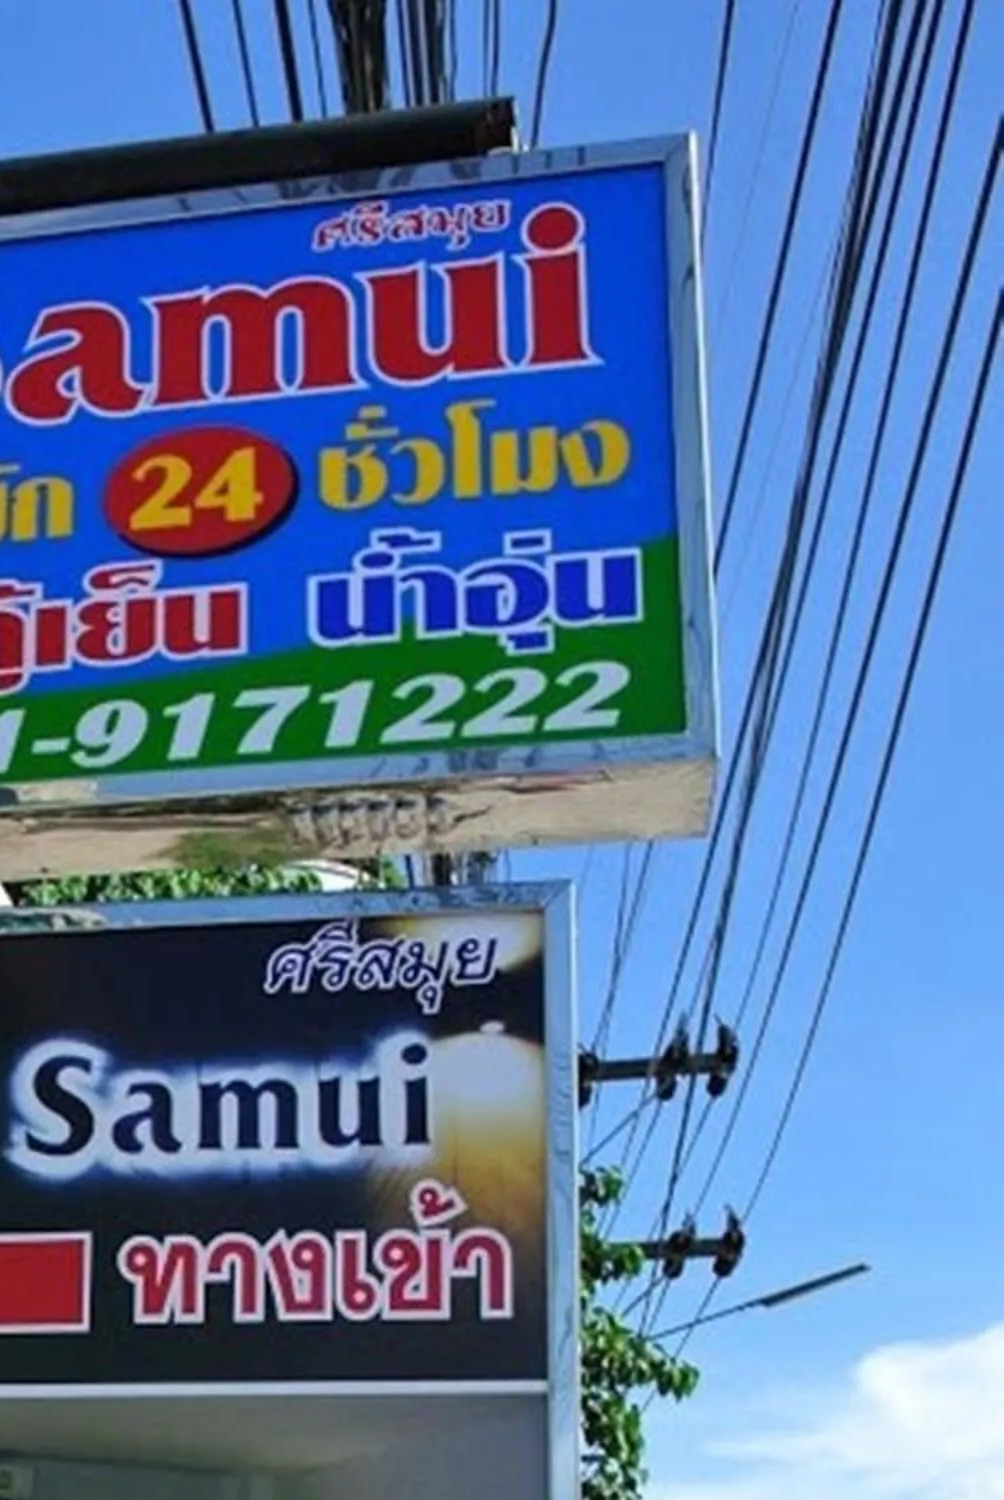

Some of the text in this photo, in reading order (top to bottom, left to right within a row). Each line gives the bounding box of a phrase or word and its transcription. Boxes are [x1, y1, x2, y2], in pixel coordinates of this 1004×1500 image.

[312, 200, 510, 251] ศรีสมุย
[129, 446, 263, 531] 24
[318, 399, 631, 510] ชั่วโมง
[307, 527, 643, 656] น้ำอุ่น
[264, 918, 497, 1014] ศรีสมุย
[25, 1043, 431, 1158] Samui
[119, 1179, 515, 1327] ทางเข้า
